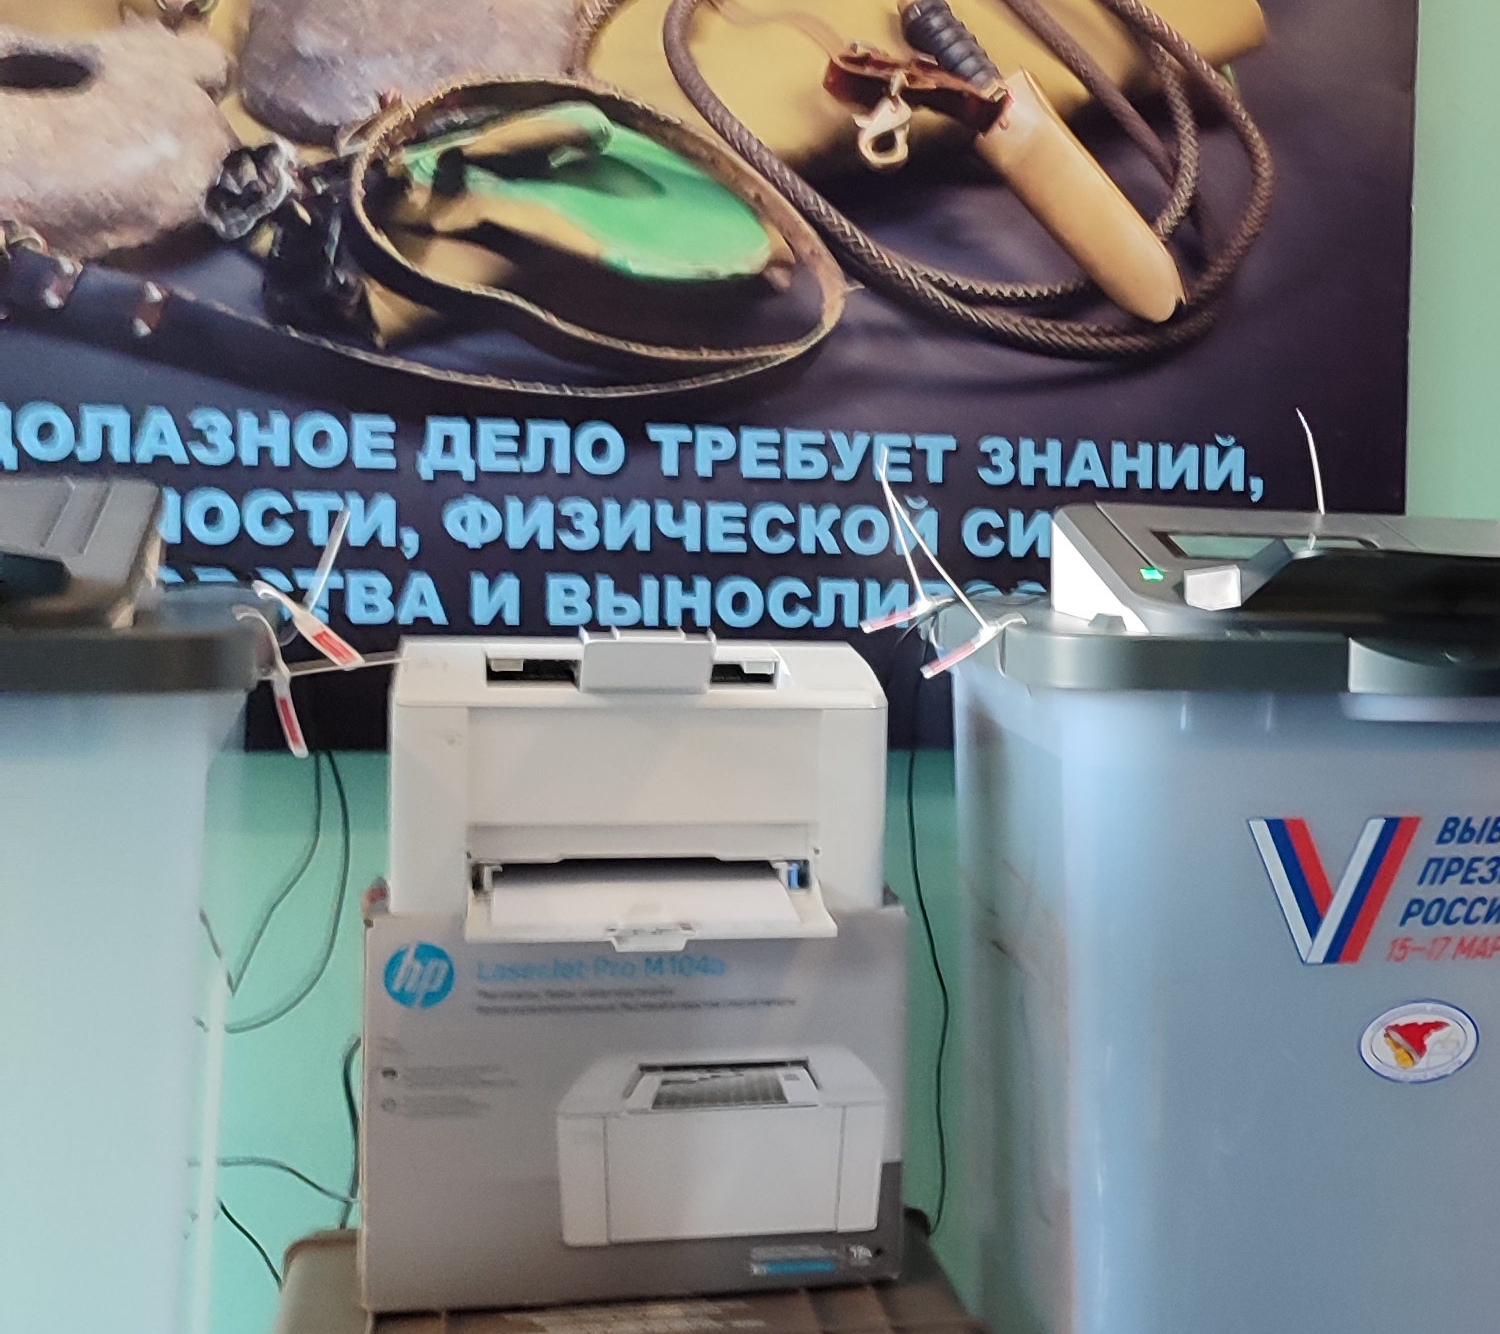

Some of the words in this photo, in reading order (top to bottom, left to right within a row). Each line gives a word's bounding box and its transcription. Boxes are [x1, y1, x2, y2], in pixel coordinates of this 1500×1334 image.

[417, 414, 625, 481] ДЕЛО
[646, 422, 957, 484] ТРЕБУЕТ
[977, 433, 1264, 503] ЗНАНИЙ,
[441, 493, 940, 558] ФИЗИЧЕСКОЙ
[469, 571, 521, 627] И
[387, 940, 453, 1008] hp
